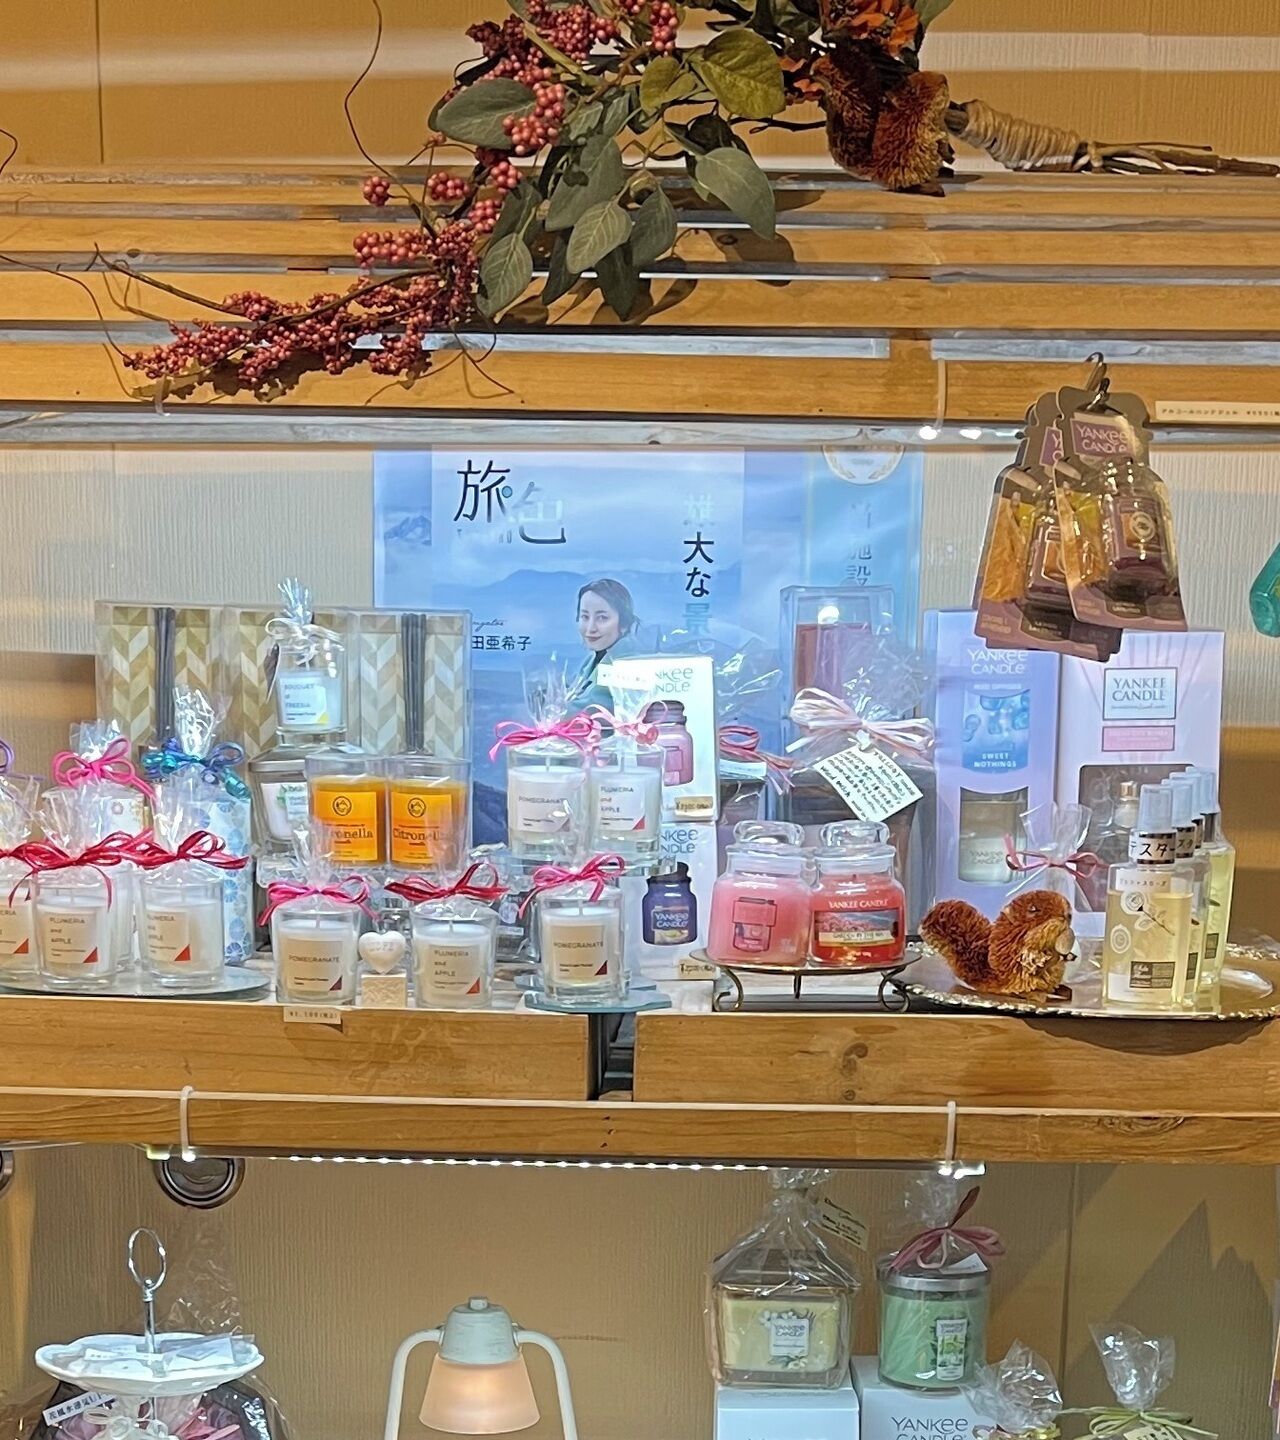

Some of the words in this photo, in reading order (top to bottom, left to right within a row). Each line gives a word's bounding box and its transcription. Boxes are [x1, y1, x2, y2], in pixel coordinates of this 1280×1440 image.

[1113, 677, 1167, 689] YANKEE
[1112, 690, 1167, 702] CANDLE
[329, 829, 374, 839] ronella
[828, 900, 859, 909] YANKEE
[860, 899, 889, 908] CANDLE
